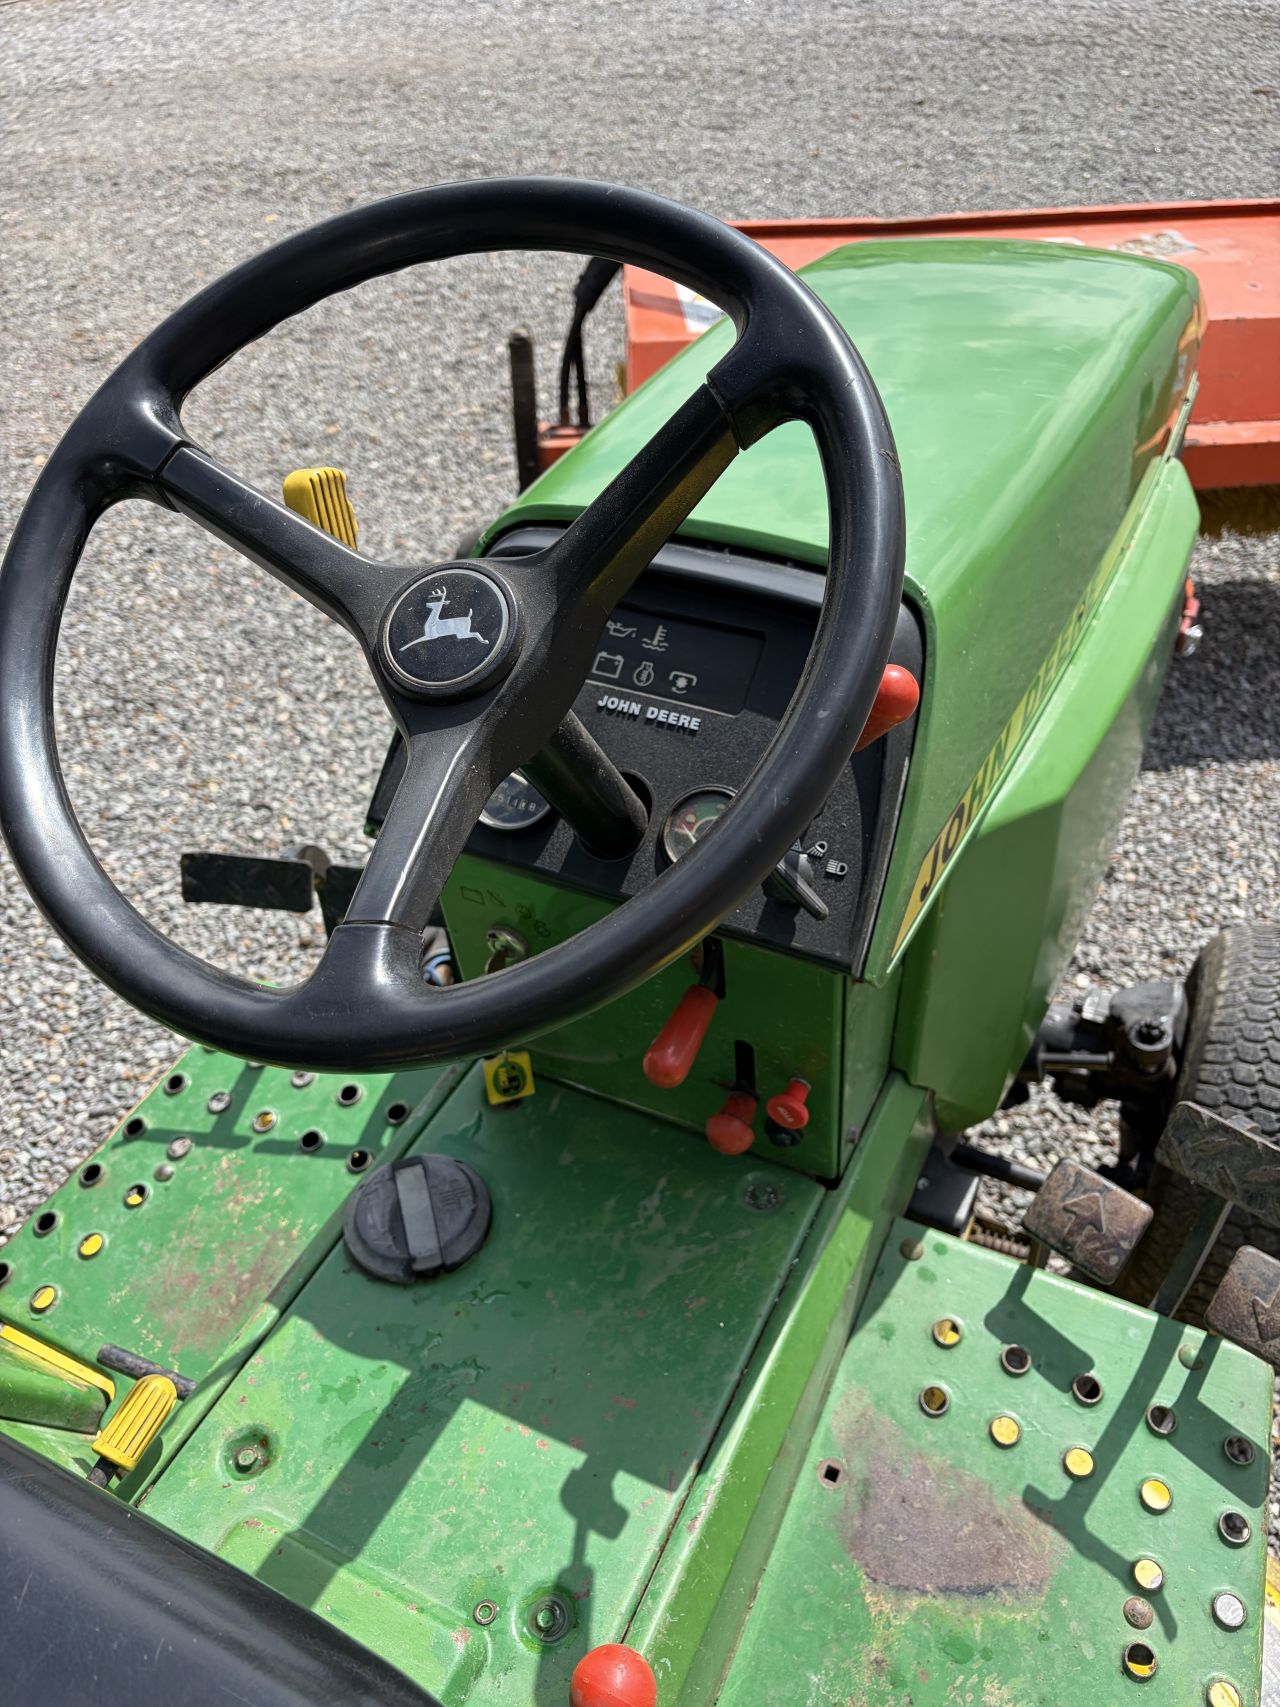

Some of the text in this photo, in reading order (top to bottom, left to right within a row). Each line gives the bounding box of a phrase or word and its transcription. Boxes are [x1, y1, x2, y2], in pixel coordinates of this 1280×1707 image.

[597, 695, 701, 731] JOHN DEERE
[920, 715, 1014, 902] JOHN
